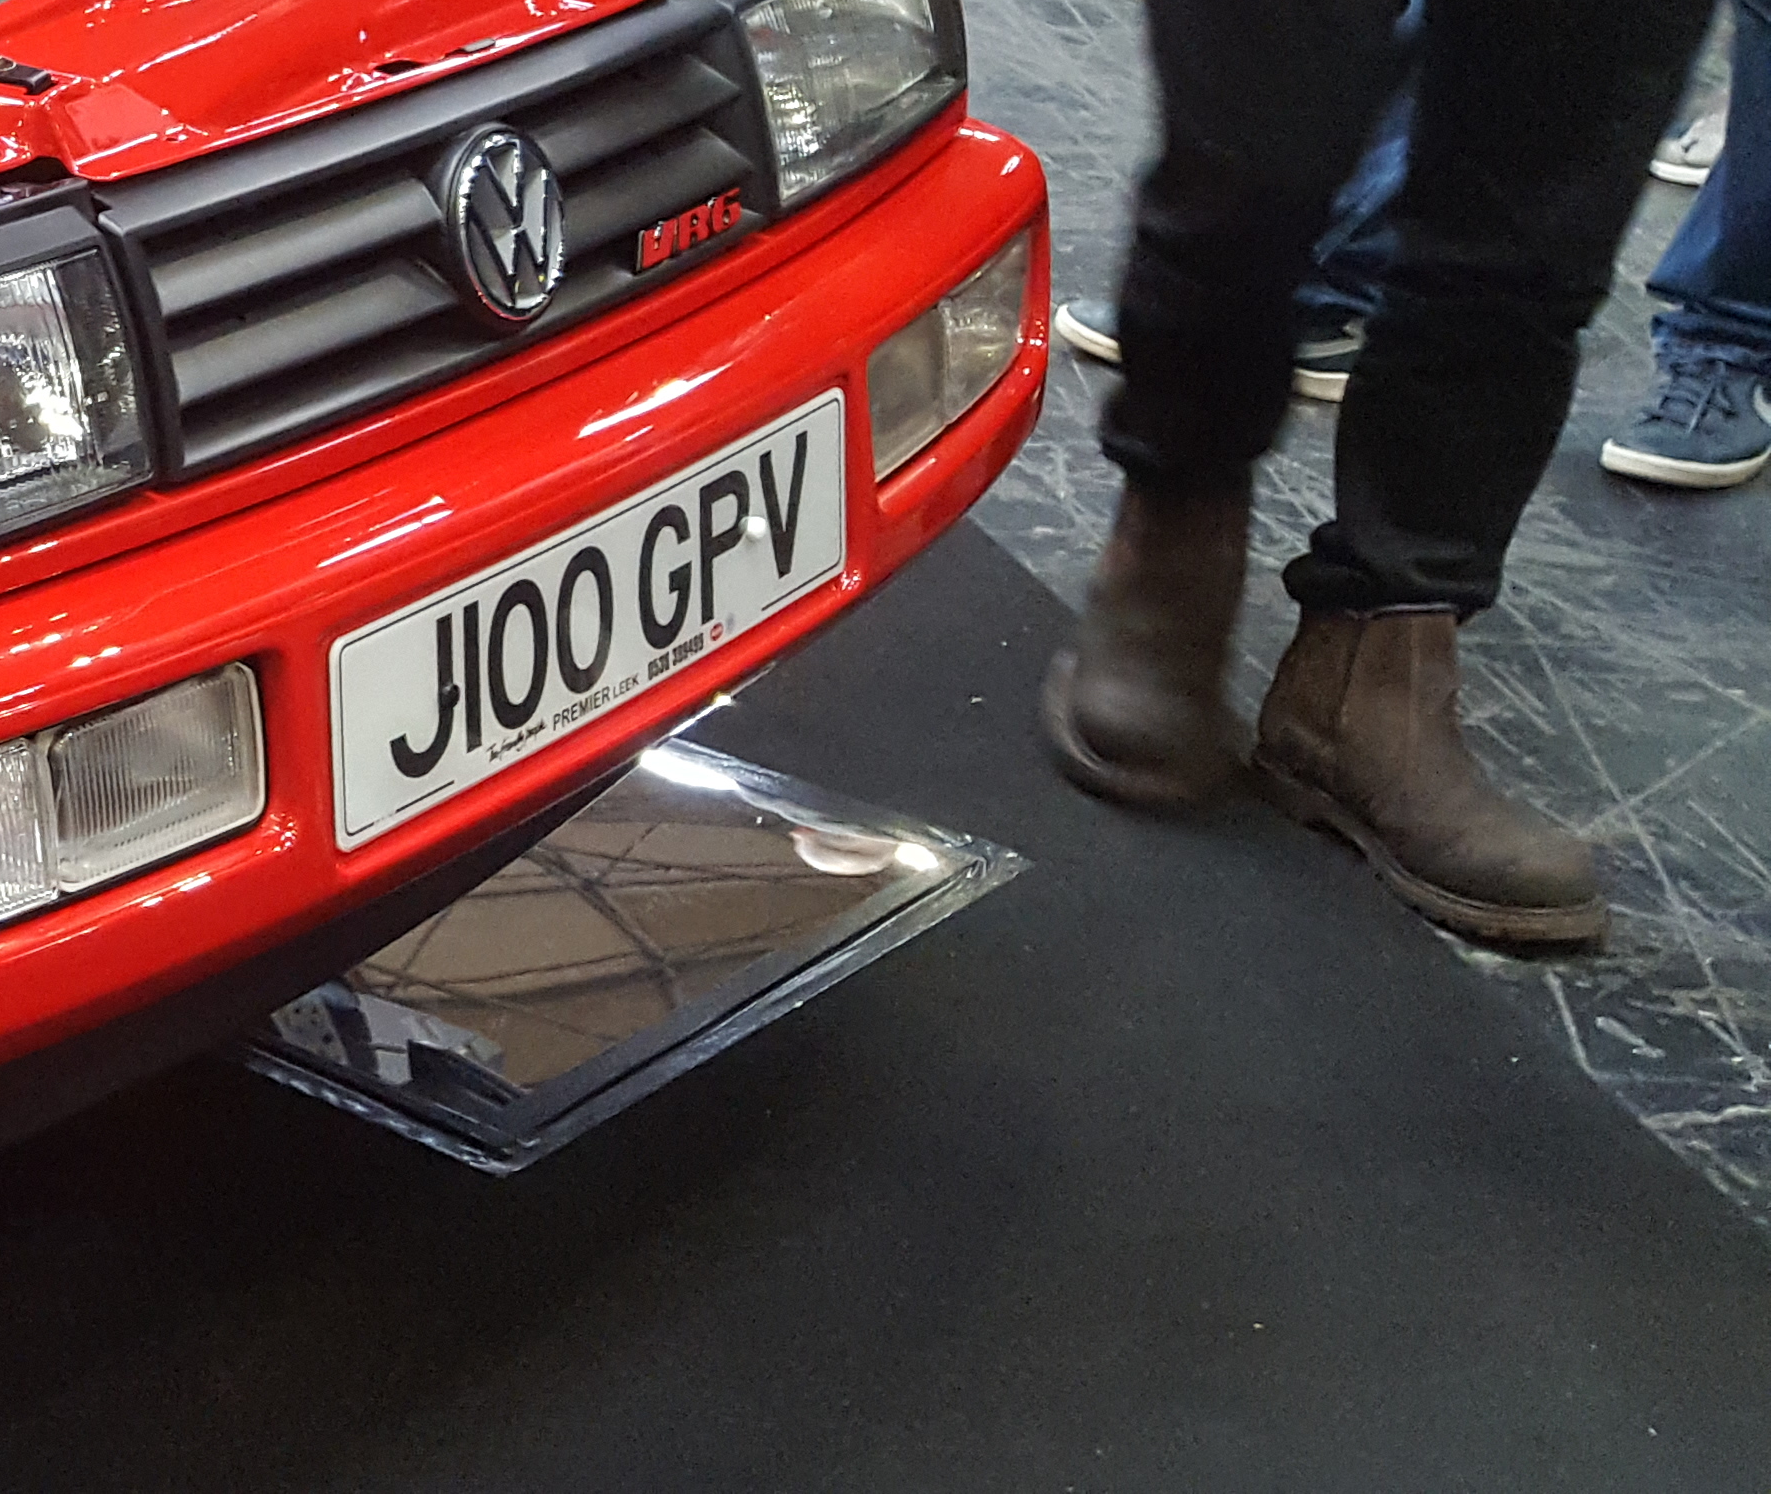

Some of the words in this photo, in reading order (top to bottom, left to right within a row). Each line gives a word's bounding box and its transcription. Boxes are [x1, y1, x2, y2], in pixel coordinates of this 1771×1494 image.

[637, 187, 741, 271] VR6
[389, 545, 614, 778] J100
[638, 431, 808, 649] GPV
[553, 686, 611, 731] PREMIER
[613, 673, 640, 699] LEEK
